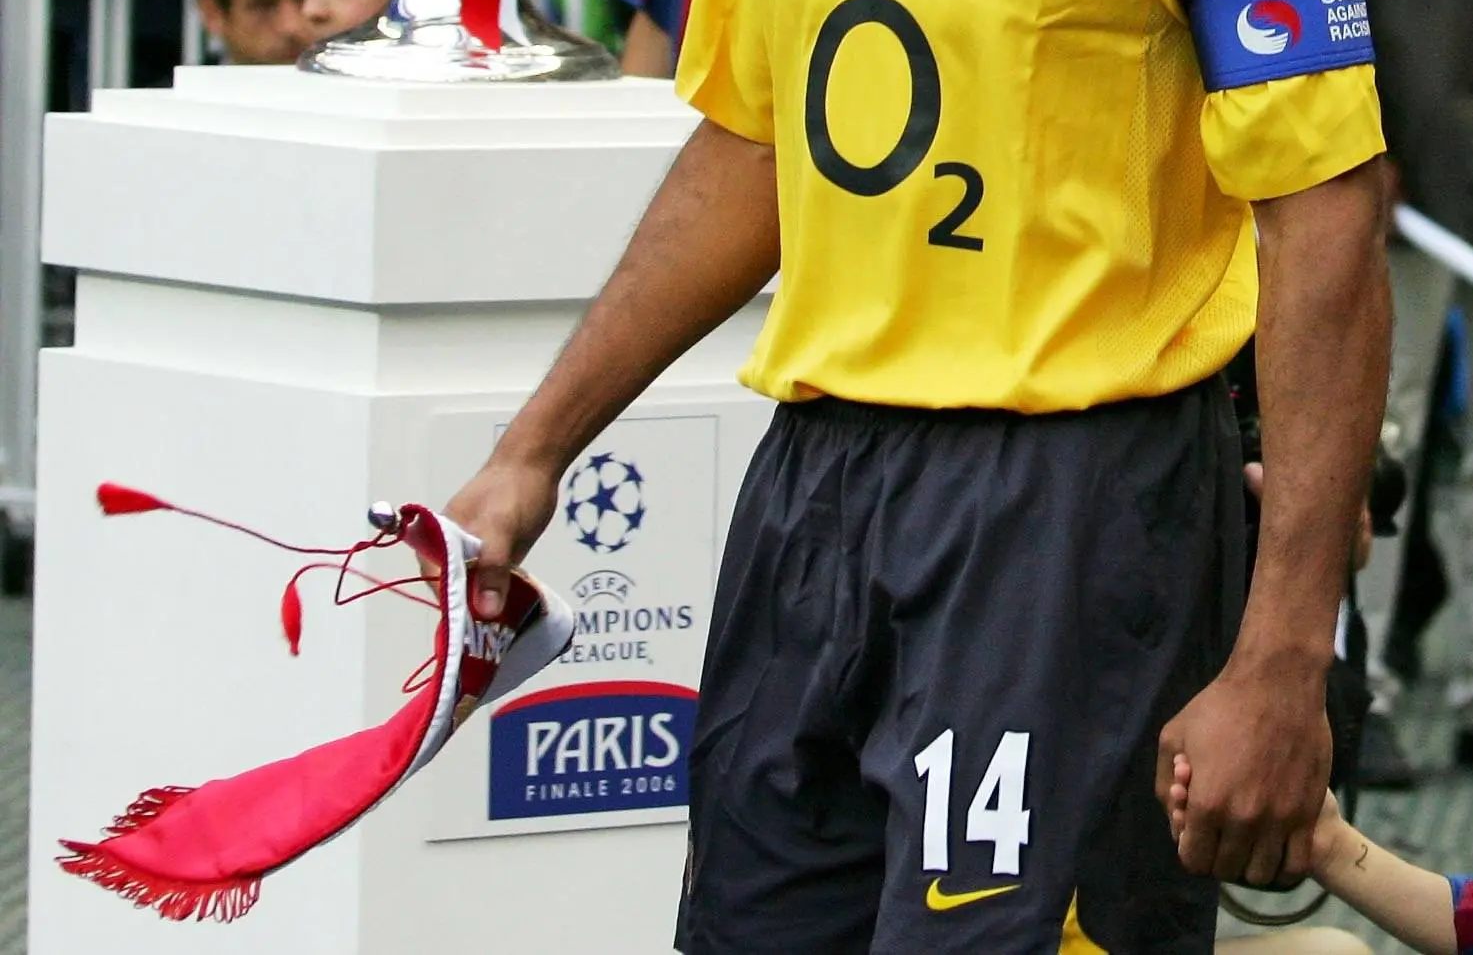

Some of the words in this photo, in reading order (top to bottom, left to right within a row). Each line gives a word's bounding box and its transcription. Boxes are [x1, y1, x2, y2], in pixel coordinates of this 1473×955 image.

[576, 576, 629, 599] UEFA
[574, 605, 694, 635] MPIONS
[526, 712, 680, 777] PARIS
[525, 779, 610, 802] FINALE
[621, 775, 677, 795] 2006
[914, 727, 1031, 876] 14
